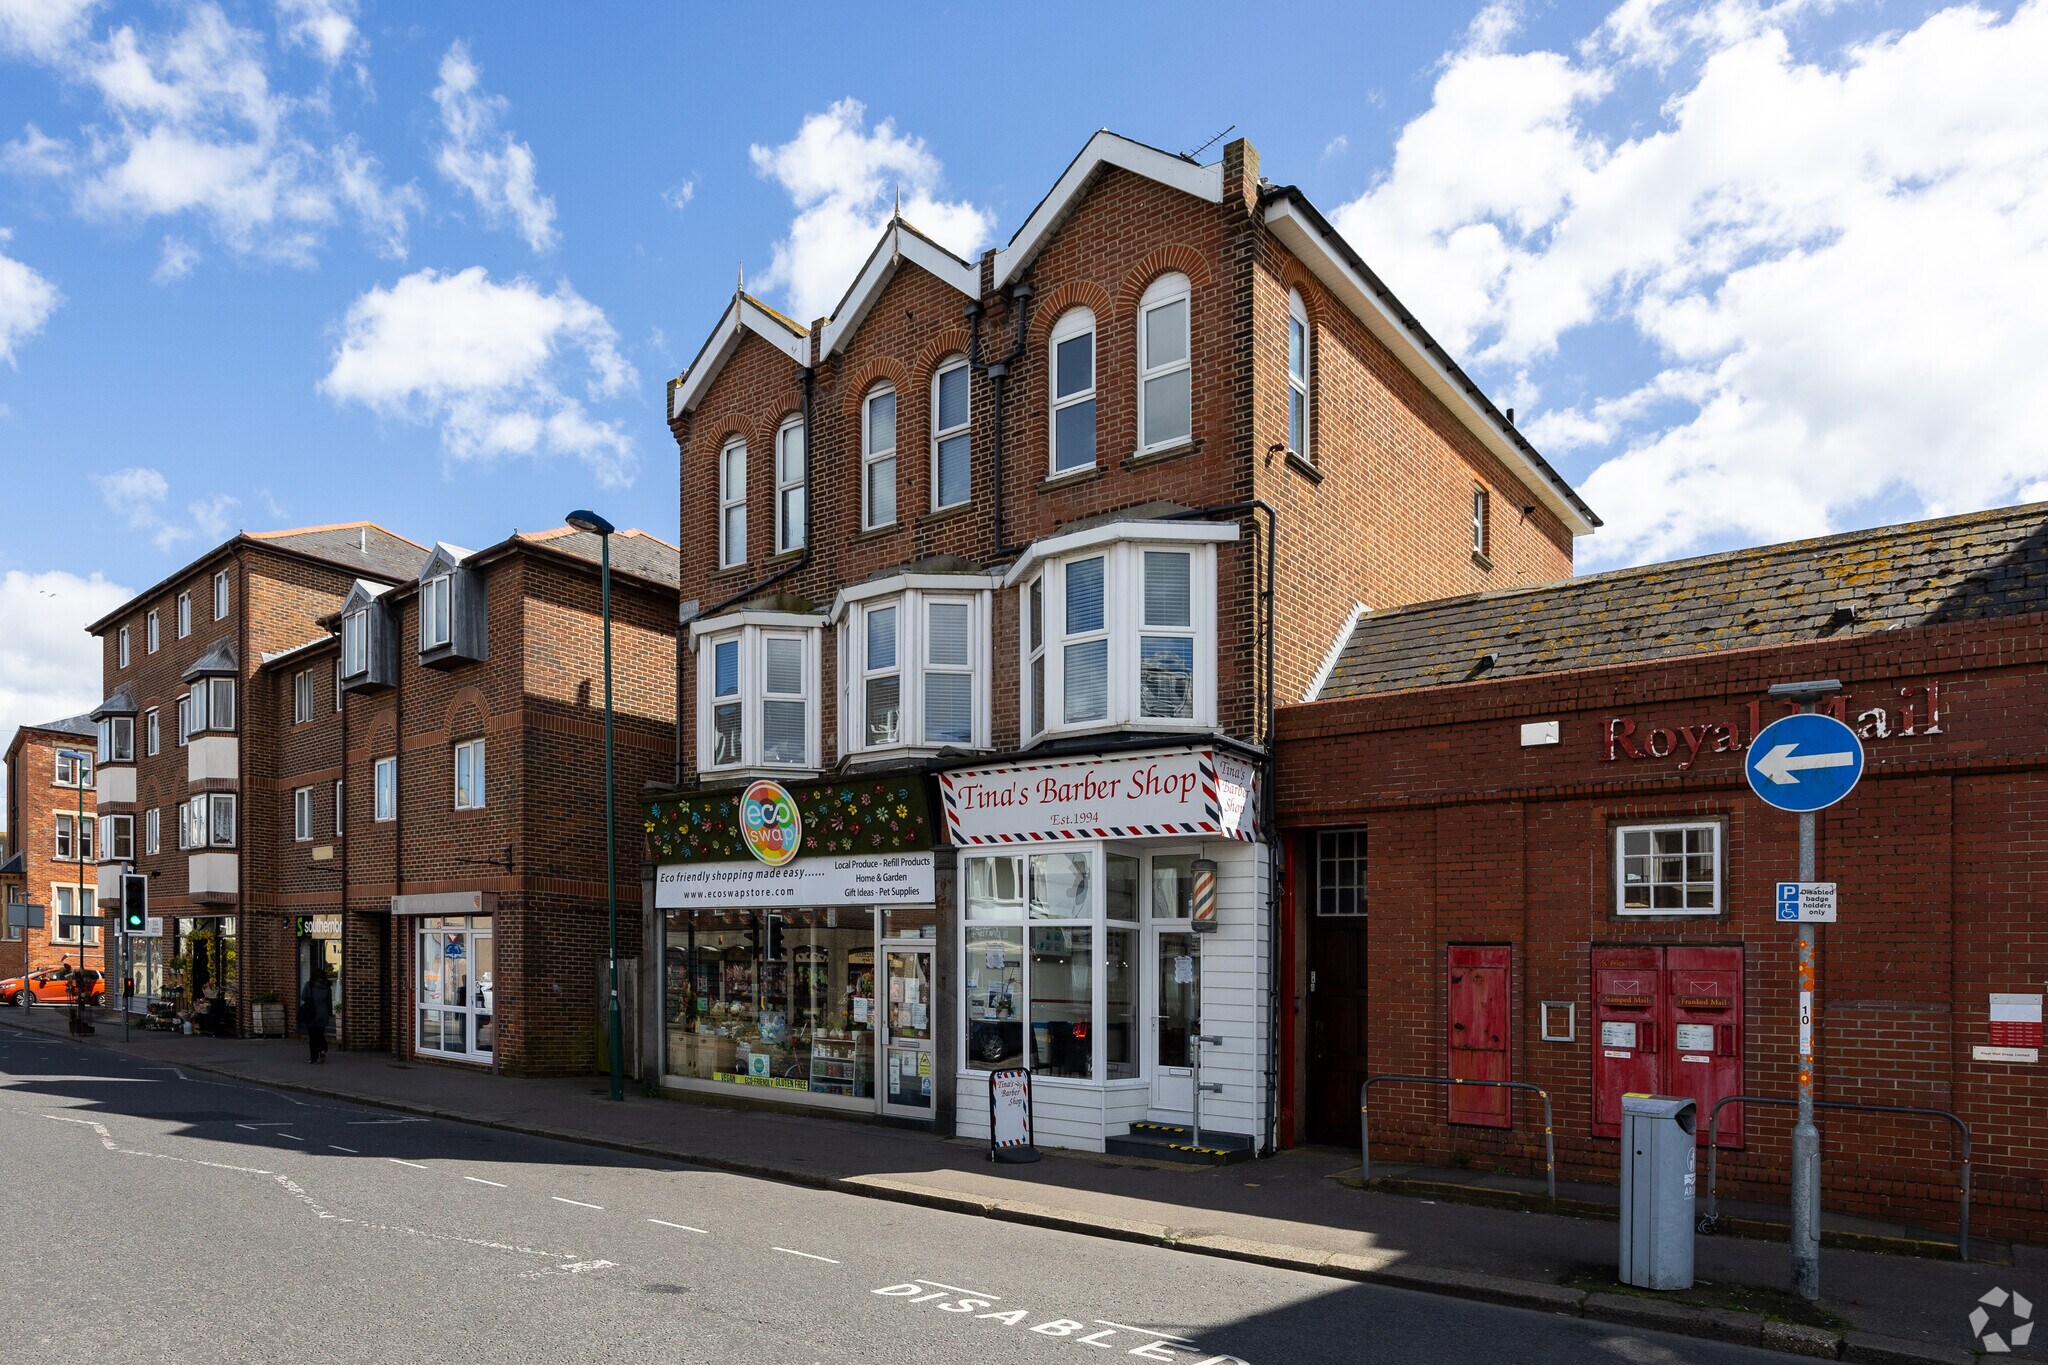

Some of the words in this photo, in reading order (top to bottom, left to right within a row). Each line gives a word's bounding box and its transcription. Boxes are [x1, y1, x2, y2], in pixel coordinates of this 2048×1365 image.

[1599, 700, 1760, 770] Royal
[1220, 761, 1246, 780] Tina's
[958, 781, 1029, 809] Tina's
[1036, 770, 1122, 804] Barber
[1127, 764, 1197, 803] Shop
[1222, 780, 1250, 799] Barber
[747, 802, 790, 825] eco
[1225, 798, 1245, 819] Shop
[1050, 812, 1099, 825] Est.1994
[750, 828, 794, 846] swap
[834, 860, 851, 870] Local
[852, 859, 878, 868] Produce
[883, 858, 900, 867] Refill
[900, 857, 931, 866] Products
[660, 873, 675, 882] Eco
[676, 871, 710, 884] friendly
[712, 869, 753, 883] shopping
[755, 868, 780, 879] made
[856, 874, 875, 882] Home
[876, 873, 882, 882] &
[883, 872, 908, 882] Garden
[683, 887, 795, 899] www.ecoswapstore.com
[844, 888, 856, 897] Gift
[857, 888, 874, 896] Ideas
[879, 888, 890, 896] Pet
[891, 886, 920, 898] Supplies
[1783, 886, 1796, 900] P
[1681, 998, 1708, 1006] Franked
[720, 1073, 736, 1082] VEGAN
[775, 1077, 794, 1088] GLUTEN
[794, 1080, 807, 1090] FREE
[997, 1080, 1014, 1088] Tina's
[1001, 1088, 1020, 1098] Barber
[1008, 1096, 1022, 1107] Shop
